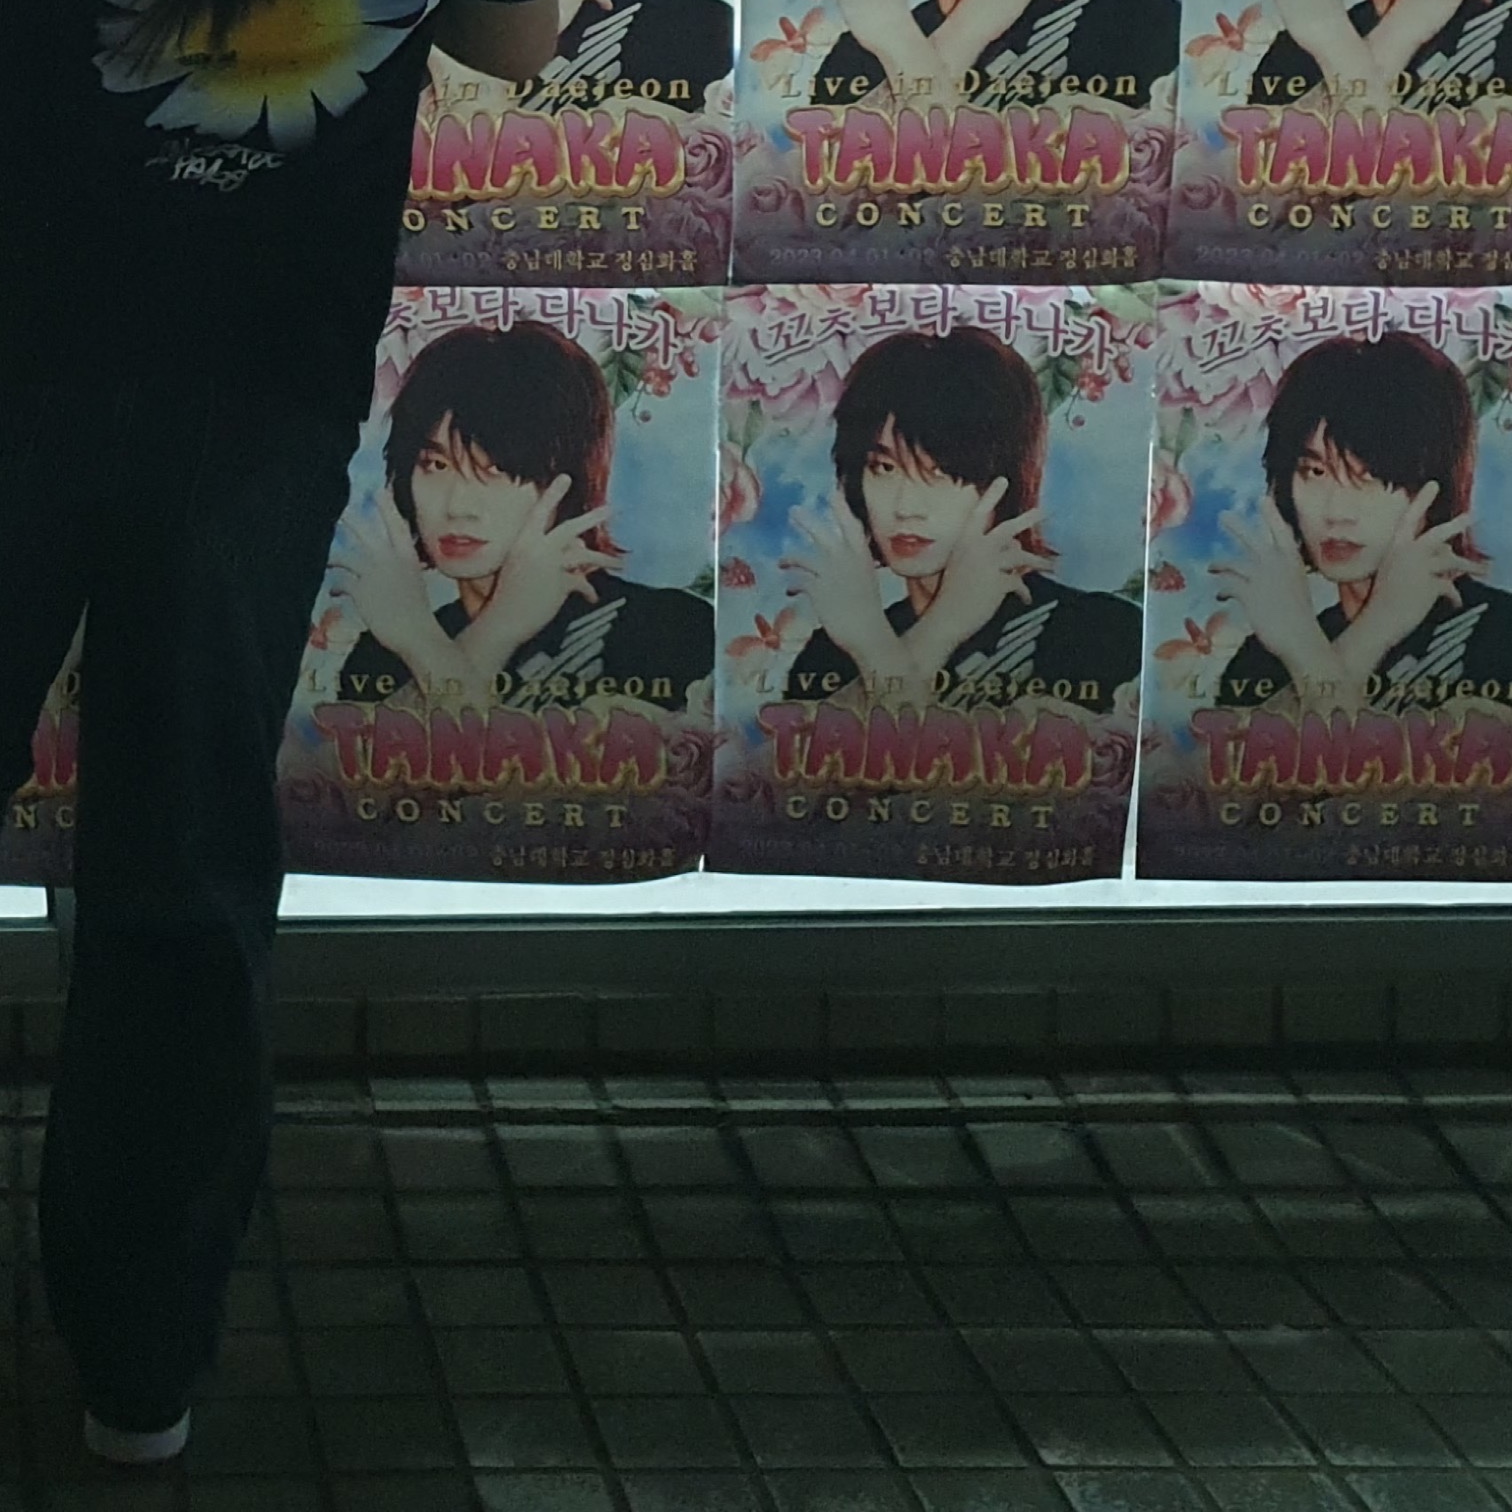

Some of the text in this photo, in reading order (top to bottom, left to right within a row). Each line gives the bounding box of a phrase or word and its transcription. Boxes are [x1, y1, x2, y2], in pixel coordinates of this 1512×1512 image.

[782, 67, 1135, 98] Live Daejeon
[1219, 72, 1306, 97] Live
[780, 100, 1131, 196] TANAKA
[401, 204, 646, 233] ONCERT
[815, 199, 1088, 228] CONCERT
[306, 668, 670, 699] Live Daejeon
[755, 667, 1100, 700] Live Daejeon
[313, 701, 669, 792] TANAKA
[752, 698, 1096, 795] TANAKA
[355, 798, 629, 827] CONCERT
[786, 796, 1052, 827] CONCERT
[1219, 800, 1481, 826] CONCERT
